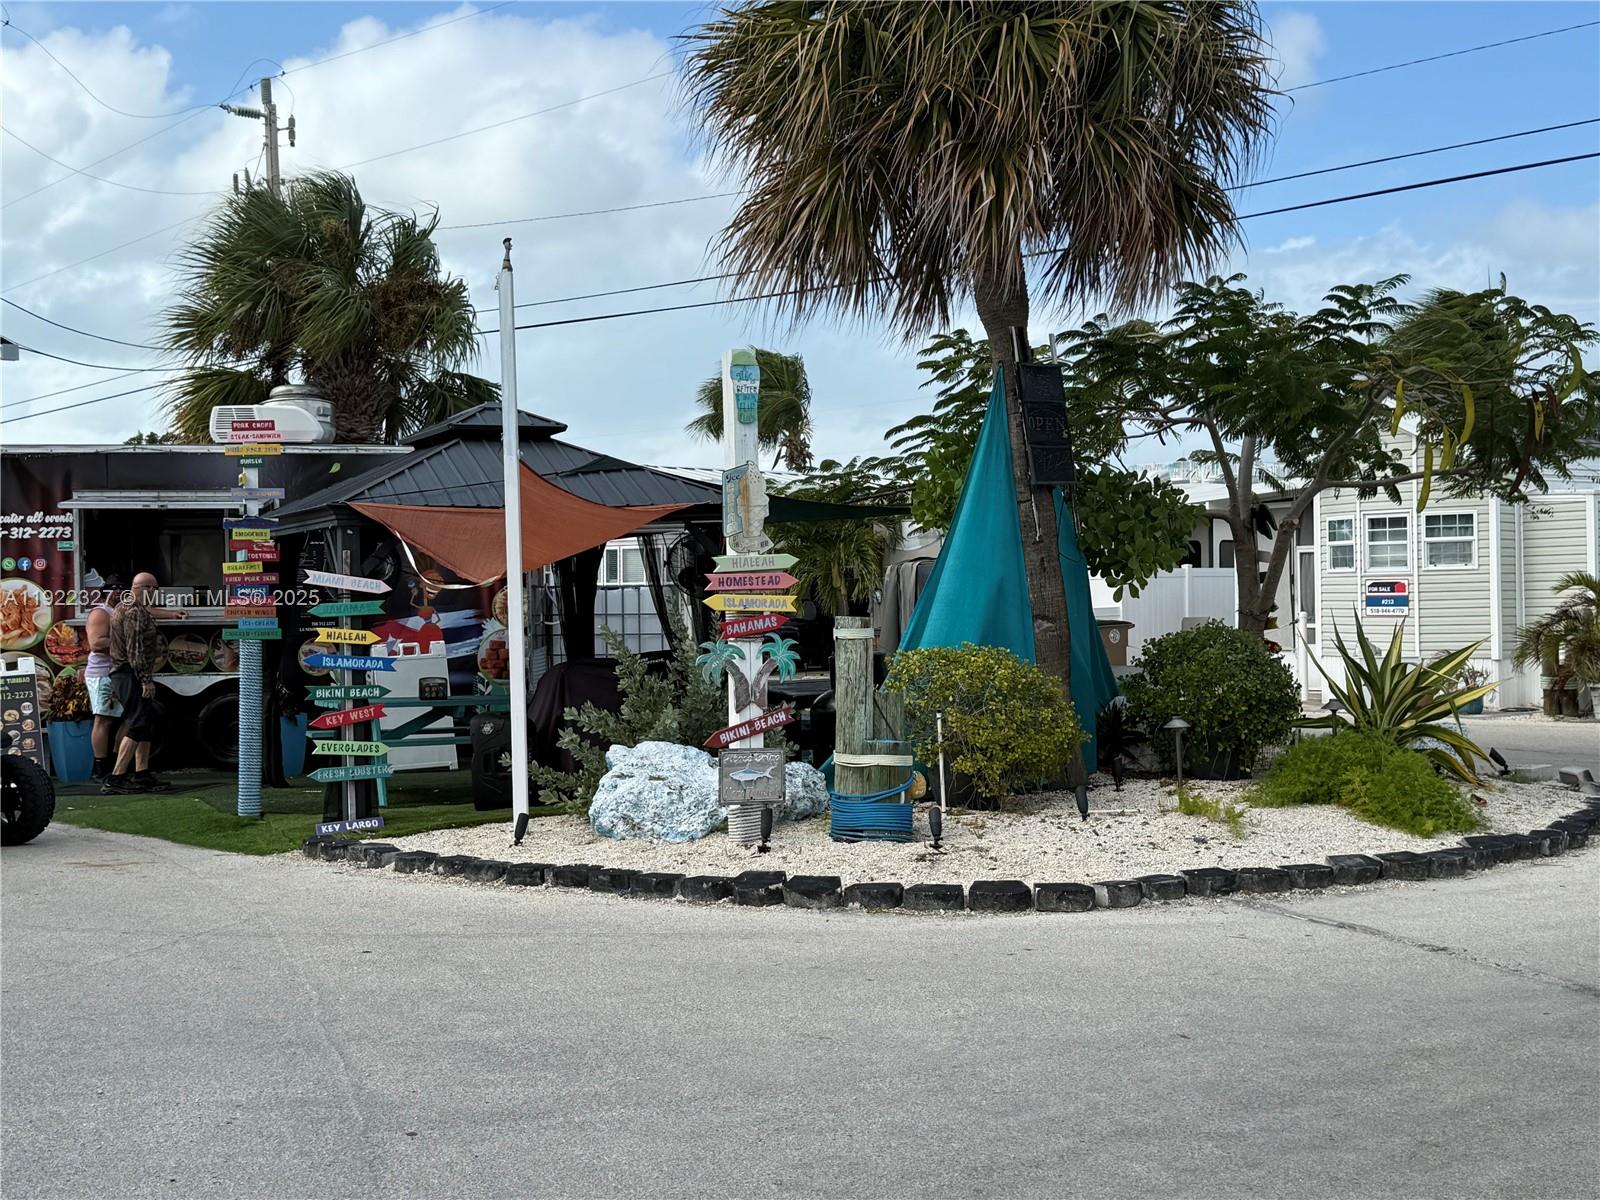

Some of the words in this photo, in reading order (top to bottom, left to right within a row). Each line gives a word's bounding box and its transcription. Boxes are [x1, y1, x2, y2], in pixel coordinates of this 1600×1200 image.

[26, 511, 43, 523] all
[44, 512, 73, 523] events
[732, 557, 775, 568] HIALEAH
[312, 573, 344, 585] MIAMI
[351, 578, 381, 589] BEACH
[718, 576, 780, 587] HOMESTEAD
[724, 598, 787, 608] ISLAMORADA
[726, 616, 777, 635] BAHAMAS
[326, 631, 367, 642] HIALEAH
[322, 656, 384, 669] ISLAMORADA
[316, 688, 345, 698] BIKINI
[350, 688, 380, 697] BEACH
[325, 714, 344, 726] KEY
[350, 707, 375, 721] WEST
[720, 724, 750, 744] BIKINI
[754, 711, 786, 731] BEACH
[321, 743, 380, 753] EVERGLADES
[317, 769, 345, 780] FRESH
[321, 823, 341, 833] KEY
[346, 818, 379, 831] LARGO
